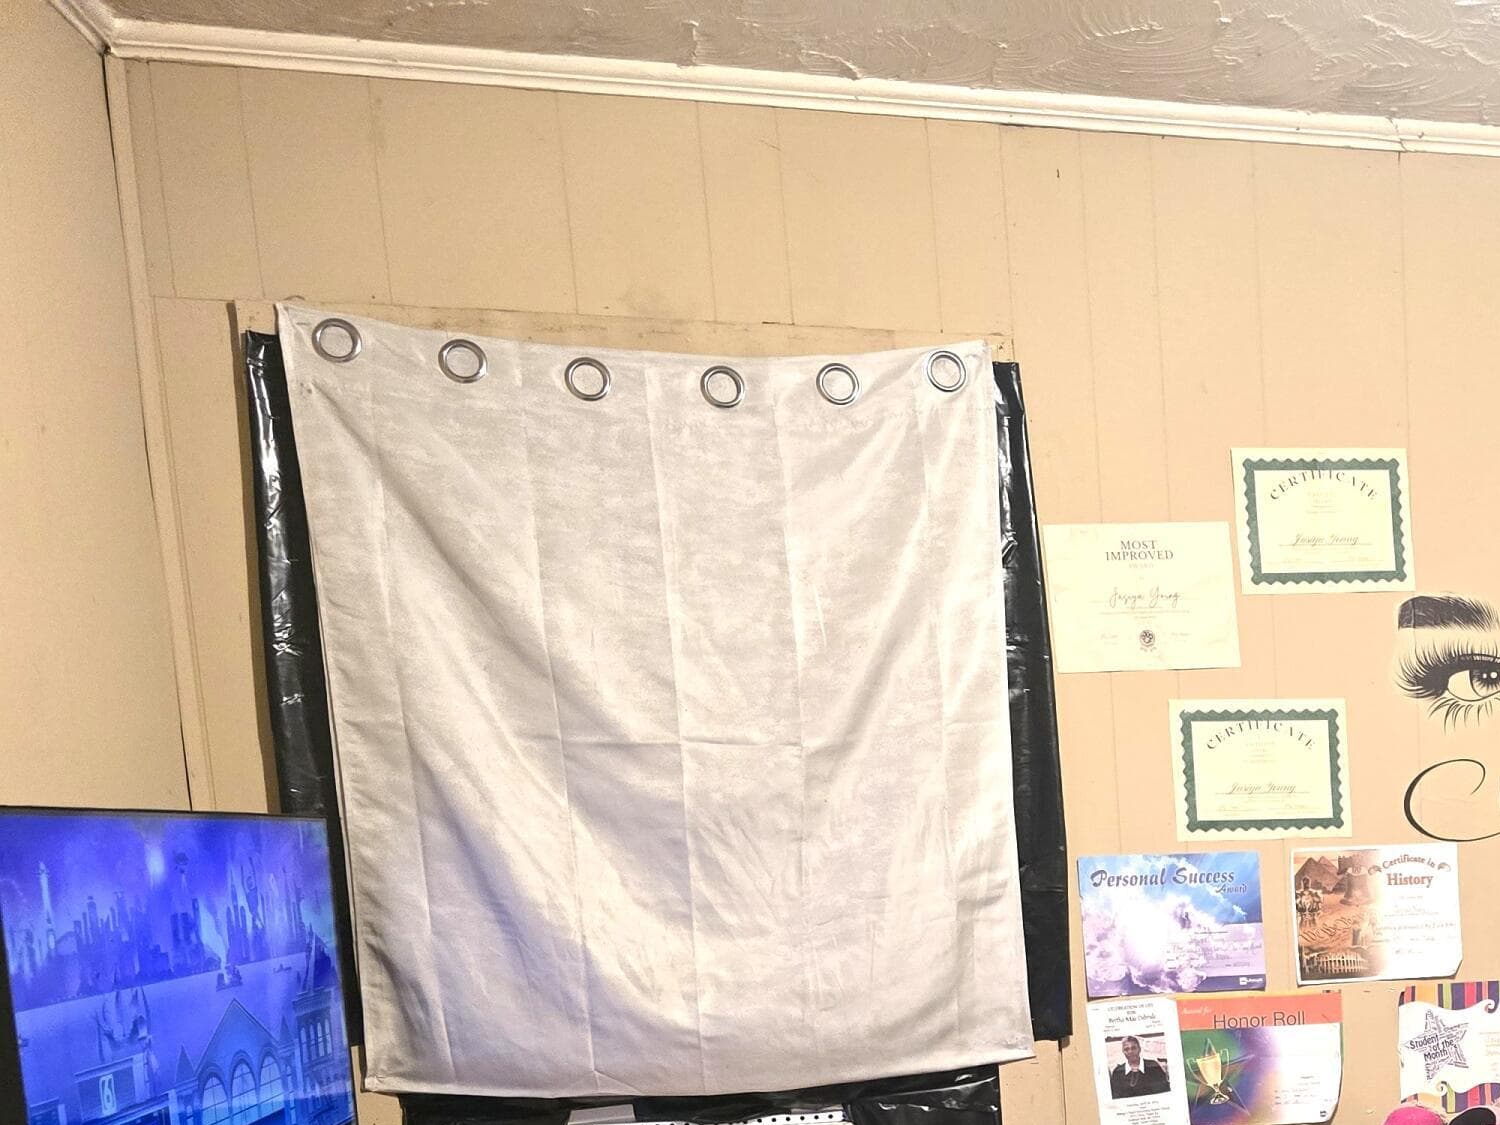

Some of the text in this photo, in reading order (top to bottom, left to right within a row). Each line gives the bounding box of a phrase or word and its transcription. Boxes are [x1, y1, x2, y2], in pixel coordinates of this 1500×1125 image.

[1120, 540, 1157, 550] MOST
[1105, 550, 1174, 561] IMPROVED
[1382, 854, 1426, 869] Certificate
[1090, 867, 1235, 887] Personal Success
[1386, 873, 1434, 888] History
[1215, 883, 1247, 894] Award
[1213, 1010, 1305, 1029] Honor Roll
[1409, 1034, 1439, 1050] Student
[1442, 1038, 1454, 1050] the
[1423, 1048, 1448, 1062] Month
